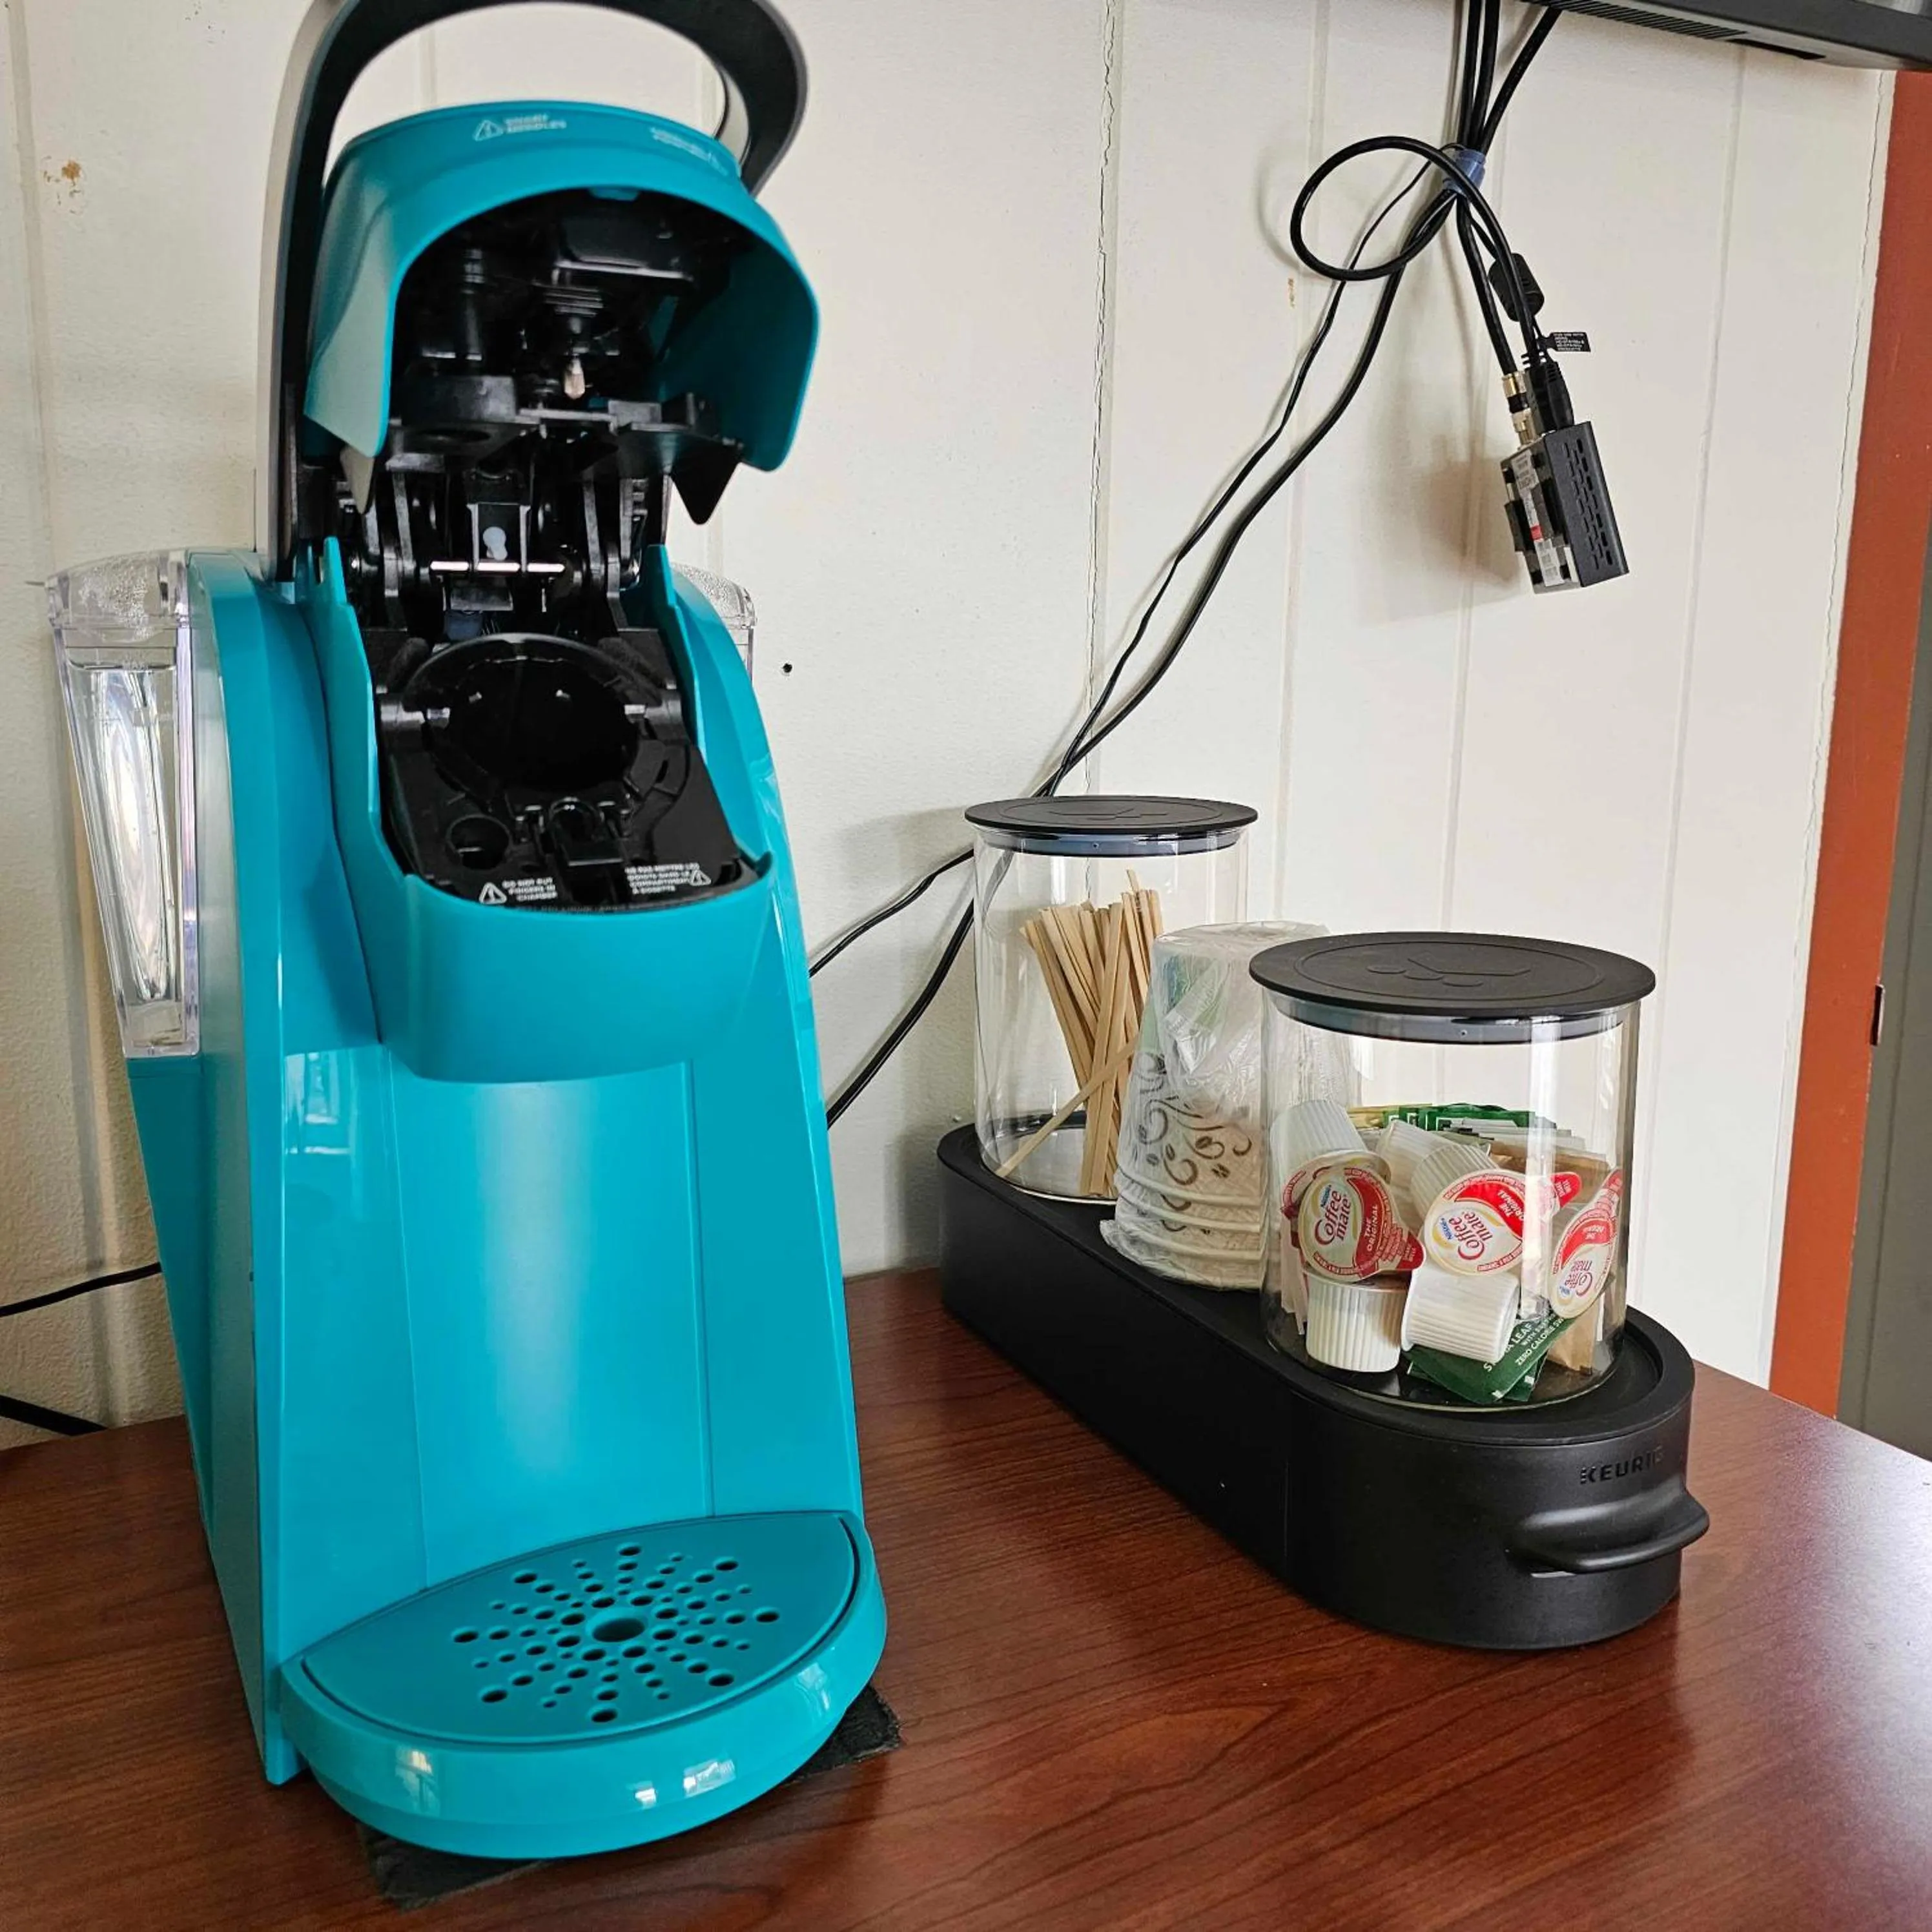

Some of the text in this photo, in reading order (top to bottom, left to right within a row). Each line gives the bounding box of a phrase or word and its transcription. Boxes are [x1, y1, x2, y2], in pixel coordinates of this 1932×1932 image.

[1315, 1190, 1342, 1245] Coffee
[1335, 1200, 1351, 1240] mate
[1364, 1218, 1373, 1238] THE
[1366, 1205, 1379, 1251] ORIGINAL
[1464, 1211, 1494, 1242] mate
[1499, 1203, 1516, 1218] THE
[1449, 1217, 1485, 1260] Coffee
[1515, 1348, 1533, 1366] ZERO
